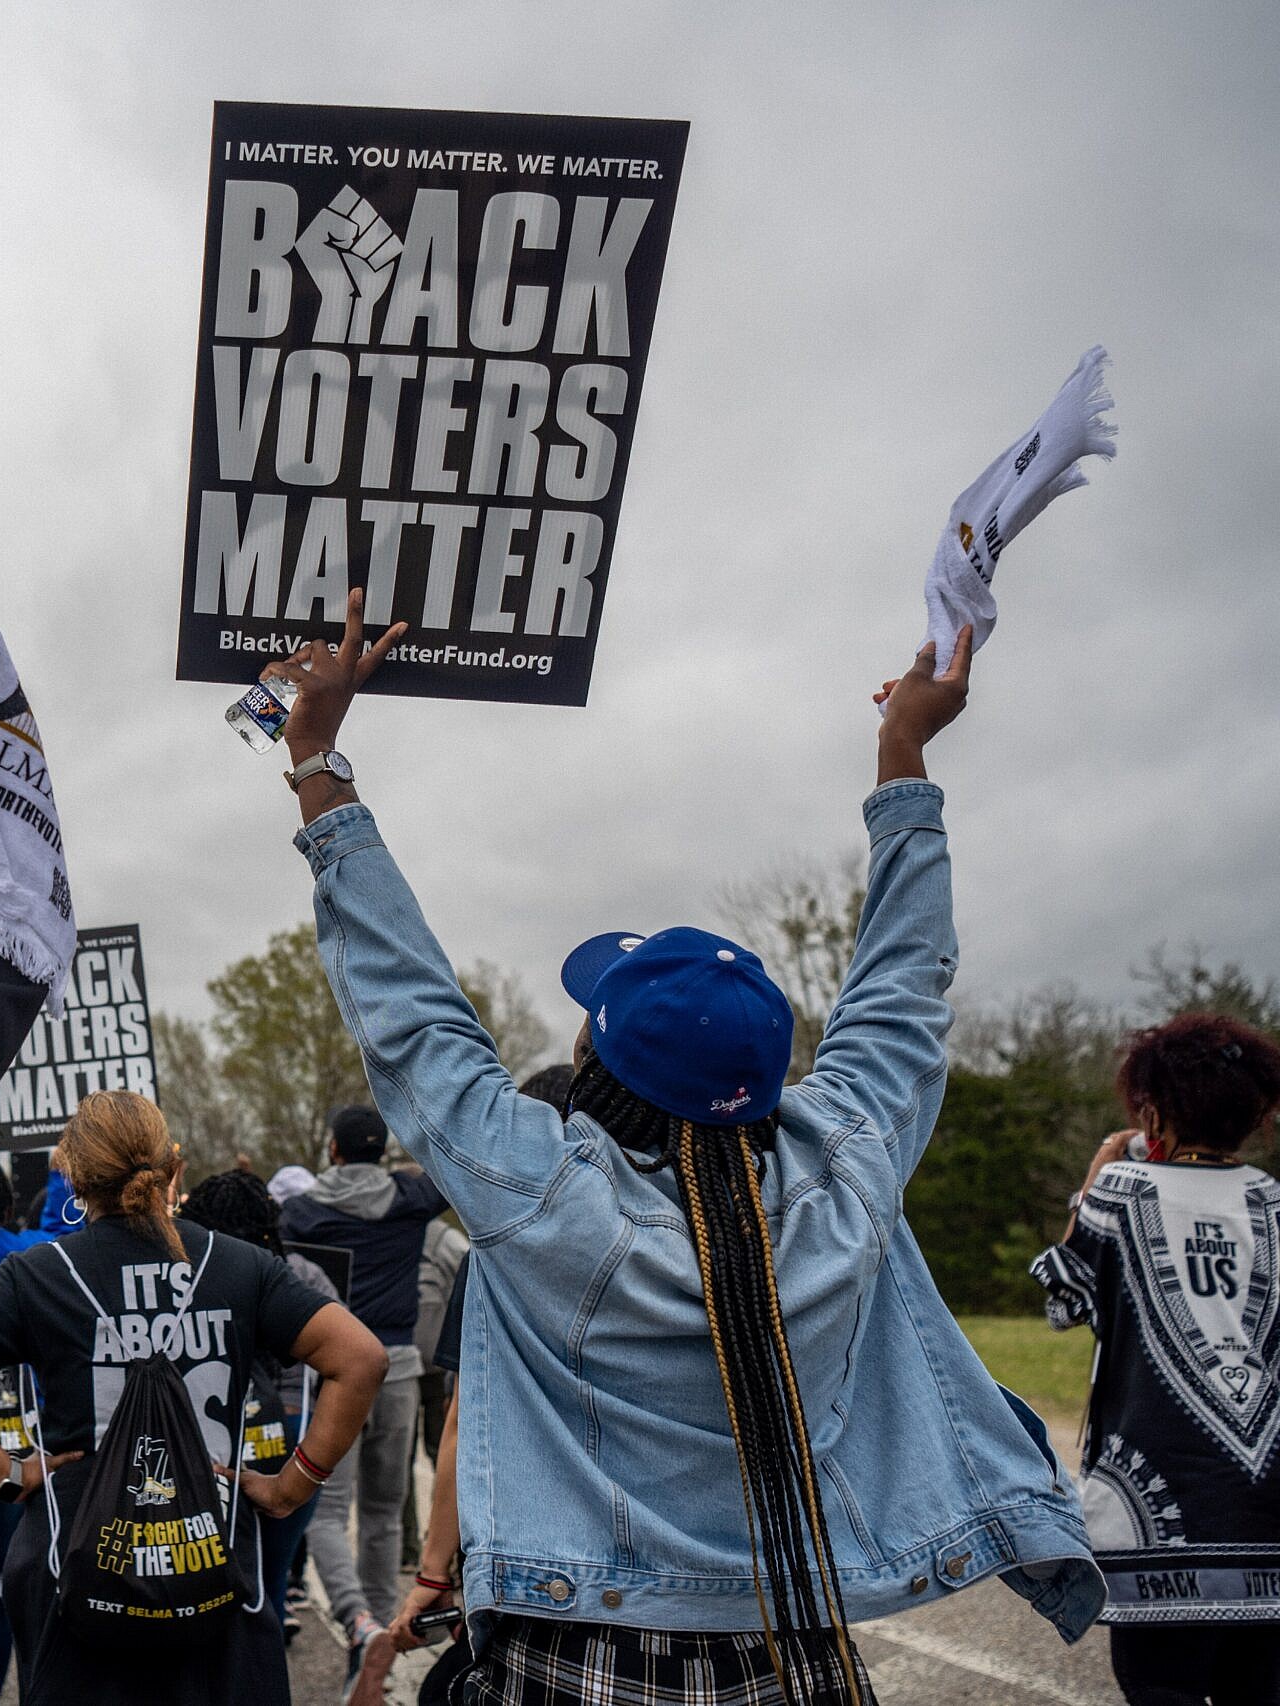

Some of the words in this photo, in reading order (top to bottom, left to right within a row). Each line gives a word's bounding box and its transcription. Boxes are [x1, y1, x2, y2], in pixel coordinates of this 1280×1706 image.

[224, 141, 232, 161] I
[239, 141, 339, 165] MATTER.
[347, 146, 400, 168] YOU
[406, 149, 508, 173] MATTER.
[517, 153, 556, 175] WE
[562, 156, 664, 180] MATTER.
[212, 344, 629, 501] VOTERS
[193, 490, 605, 637] MATTER
[19, 1002, 150, 1067] OTERS
[710, 1094, 752, 1112] Dodgers
[1184, 1238, 1238, 1258] ABOUT
[1194, 1221, 1224, 1240] IT'S
[121, 1261, 194, 1311] IT'S
[1185, 1254, 1238, 1301] US
[92, 1308, 233, 1363] ABOUT
[87, 1597, 125, 1614] TEXT
[126, 1605, 173, 1619] SELMA
[175, 1605, 196, 1618] TO
